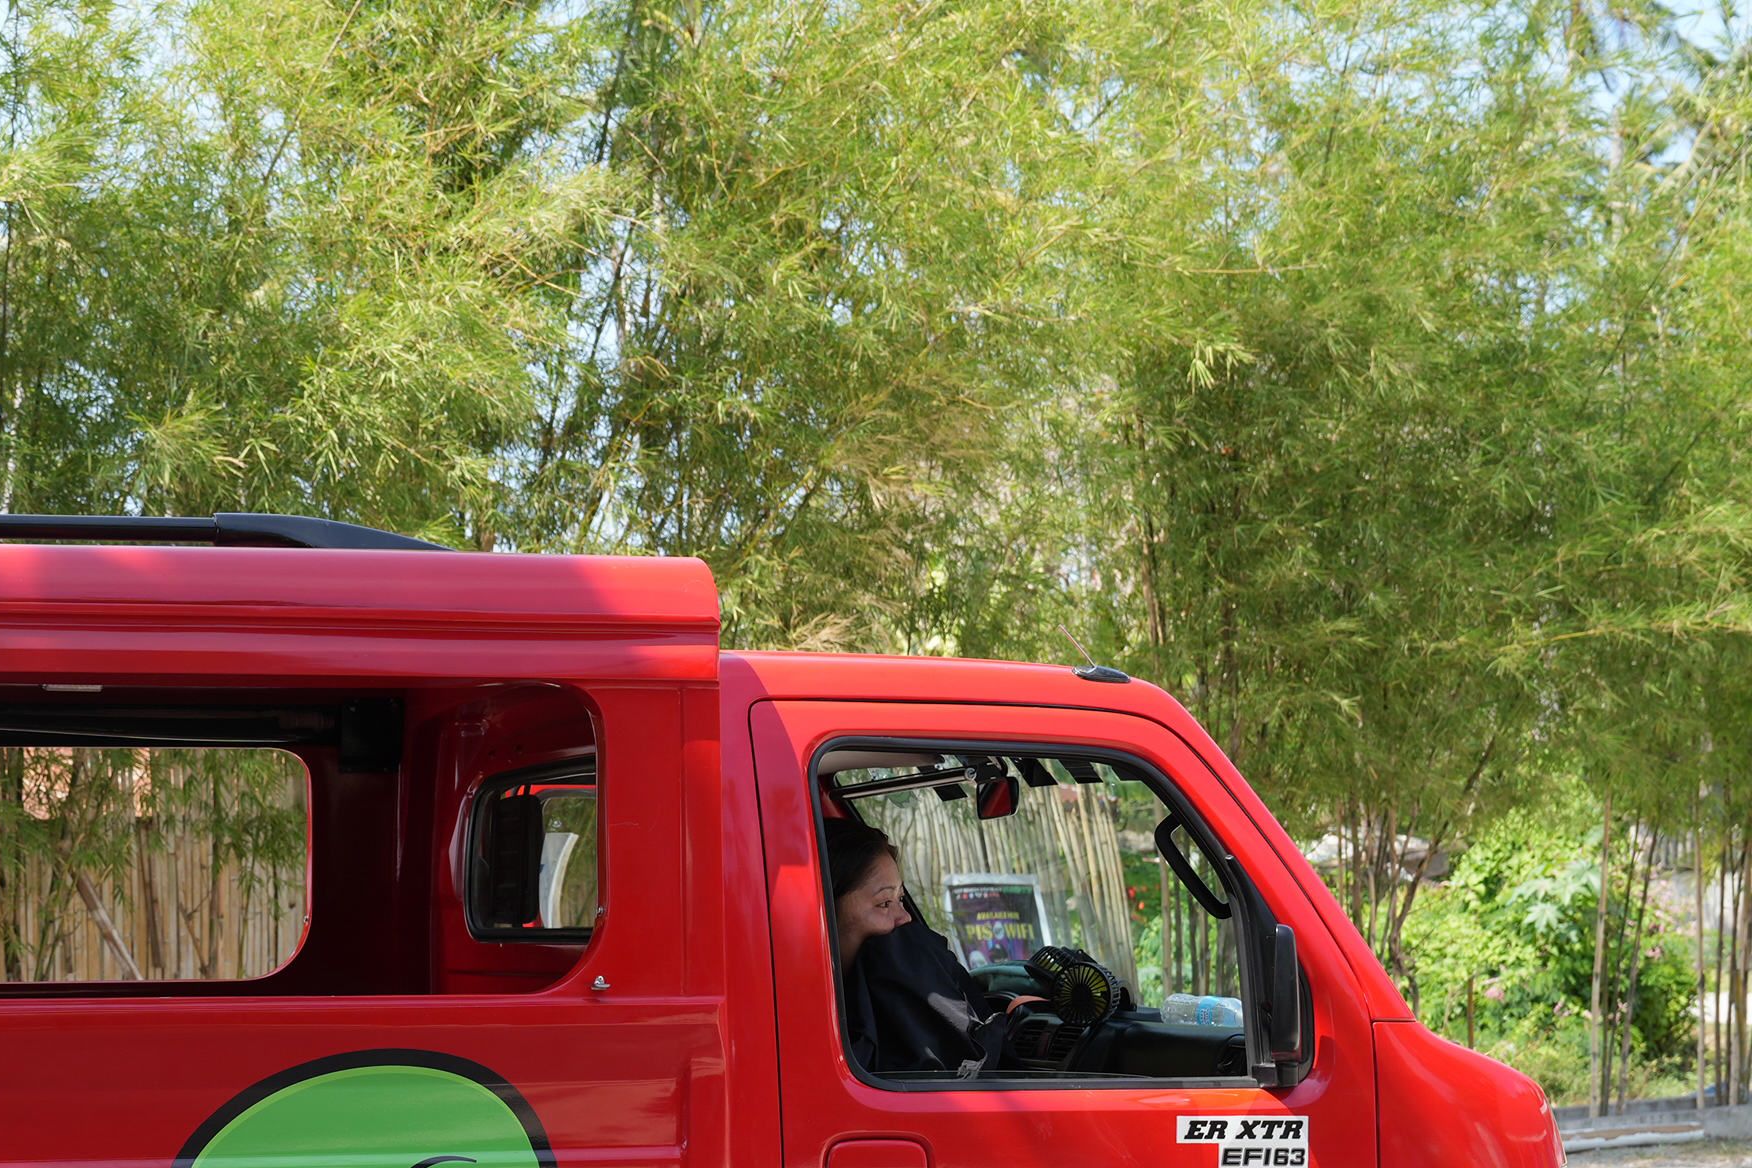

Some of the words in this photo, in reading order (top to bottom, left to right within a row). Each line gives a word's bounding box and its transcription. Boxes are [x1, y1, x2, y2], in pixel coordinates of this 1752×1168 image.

[1004, 923, 1035, 939] WIFI
[1184, 1120, 1228, 1140] ER
[1235, 1120, 1304, 1140] XTR
